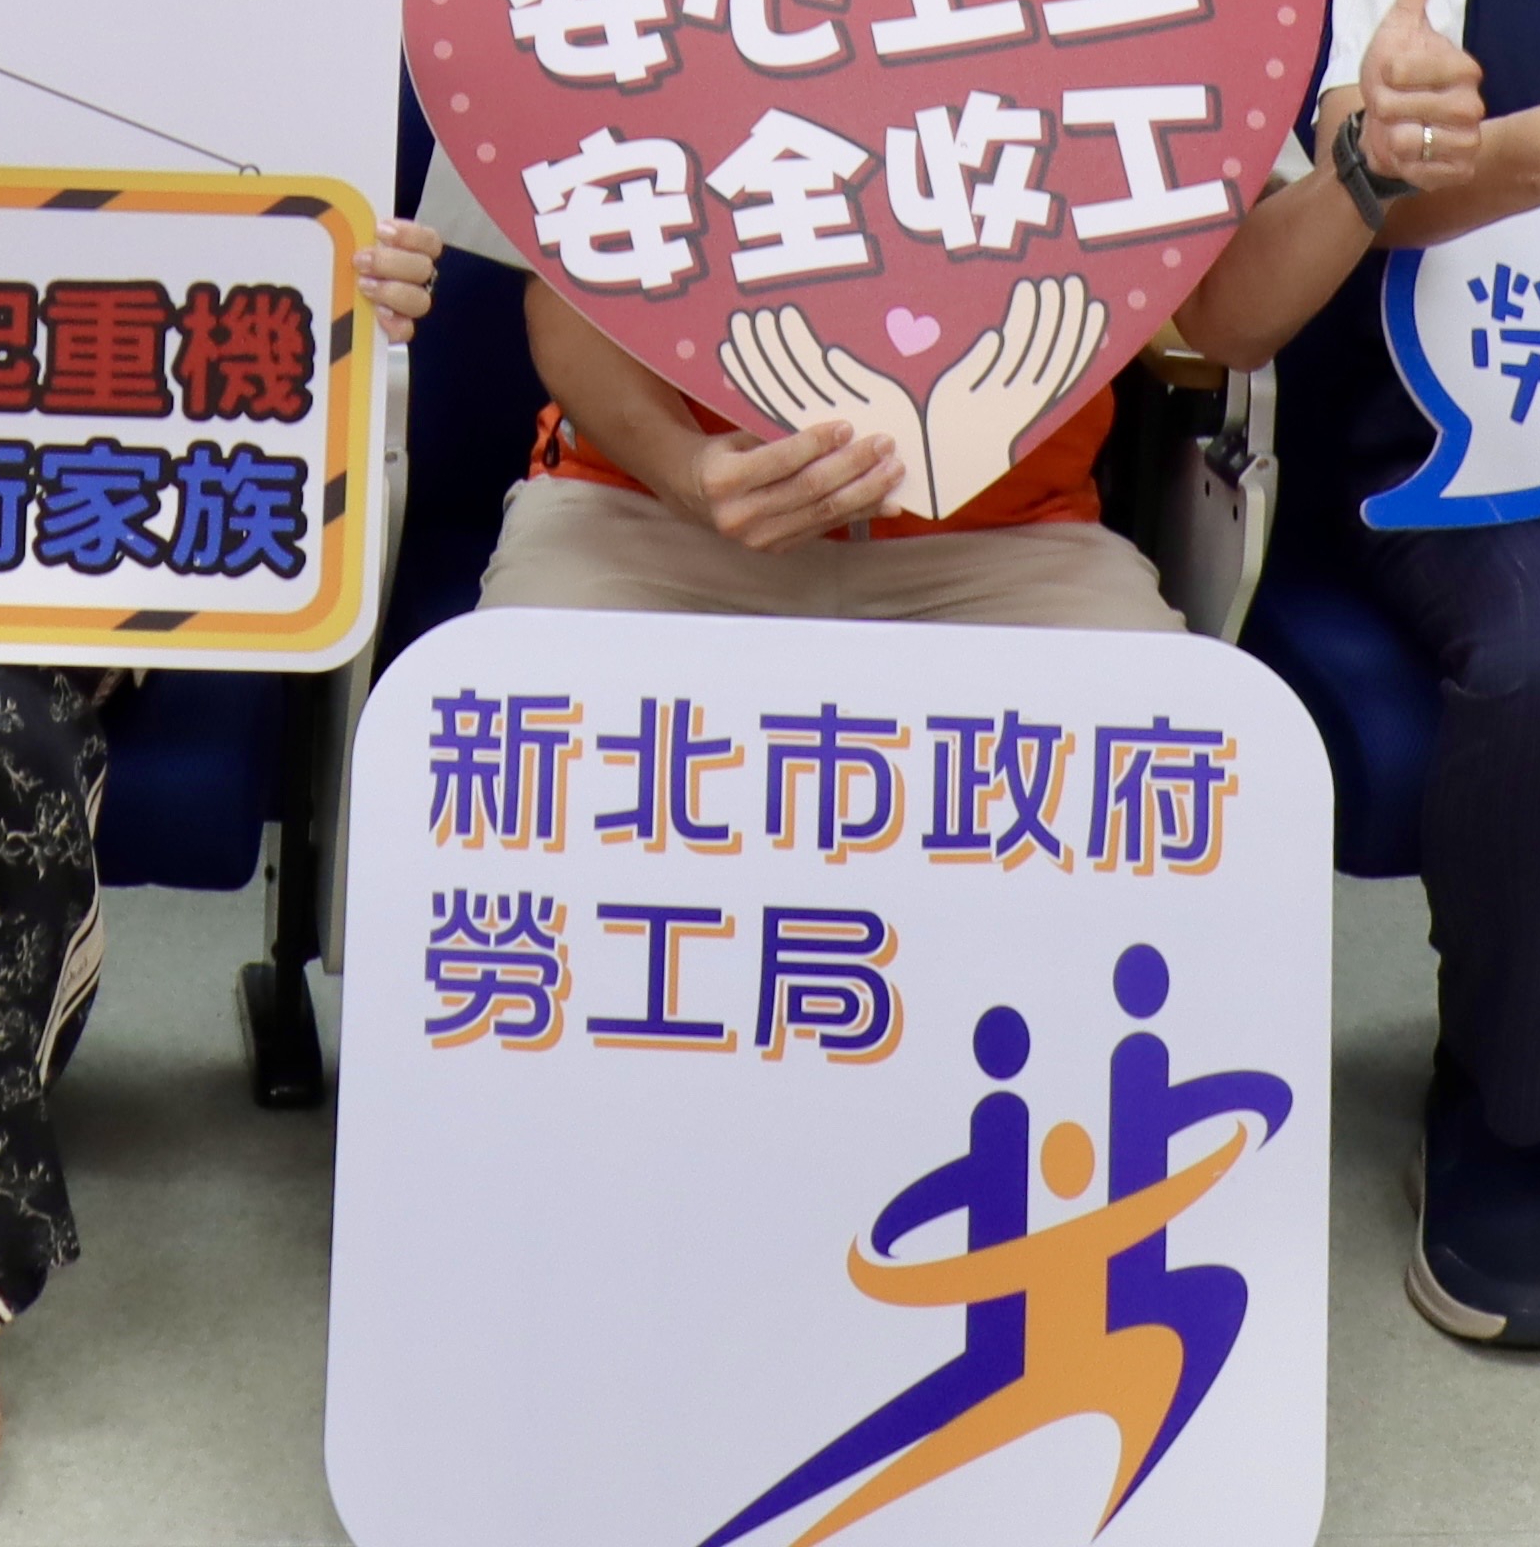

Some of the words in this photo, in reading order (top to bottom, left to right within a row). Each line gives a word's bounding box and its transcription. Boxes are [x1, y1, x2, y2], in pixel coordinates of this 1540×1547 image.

[521, 84, 1238, 298] 安全收工
[428, 688, 1238, 877] 新北市政府
[423, 888, 904, 1066] 勞工局
